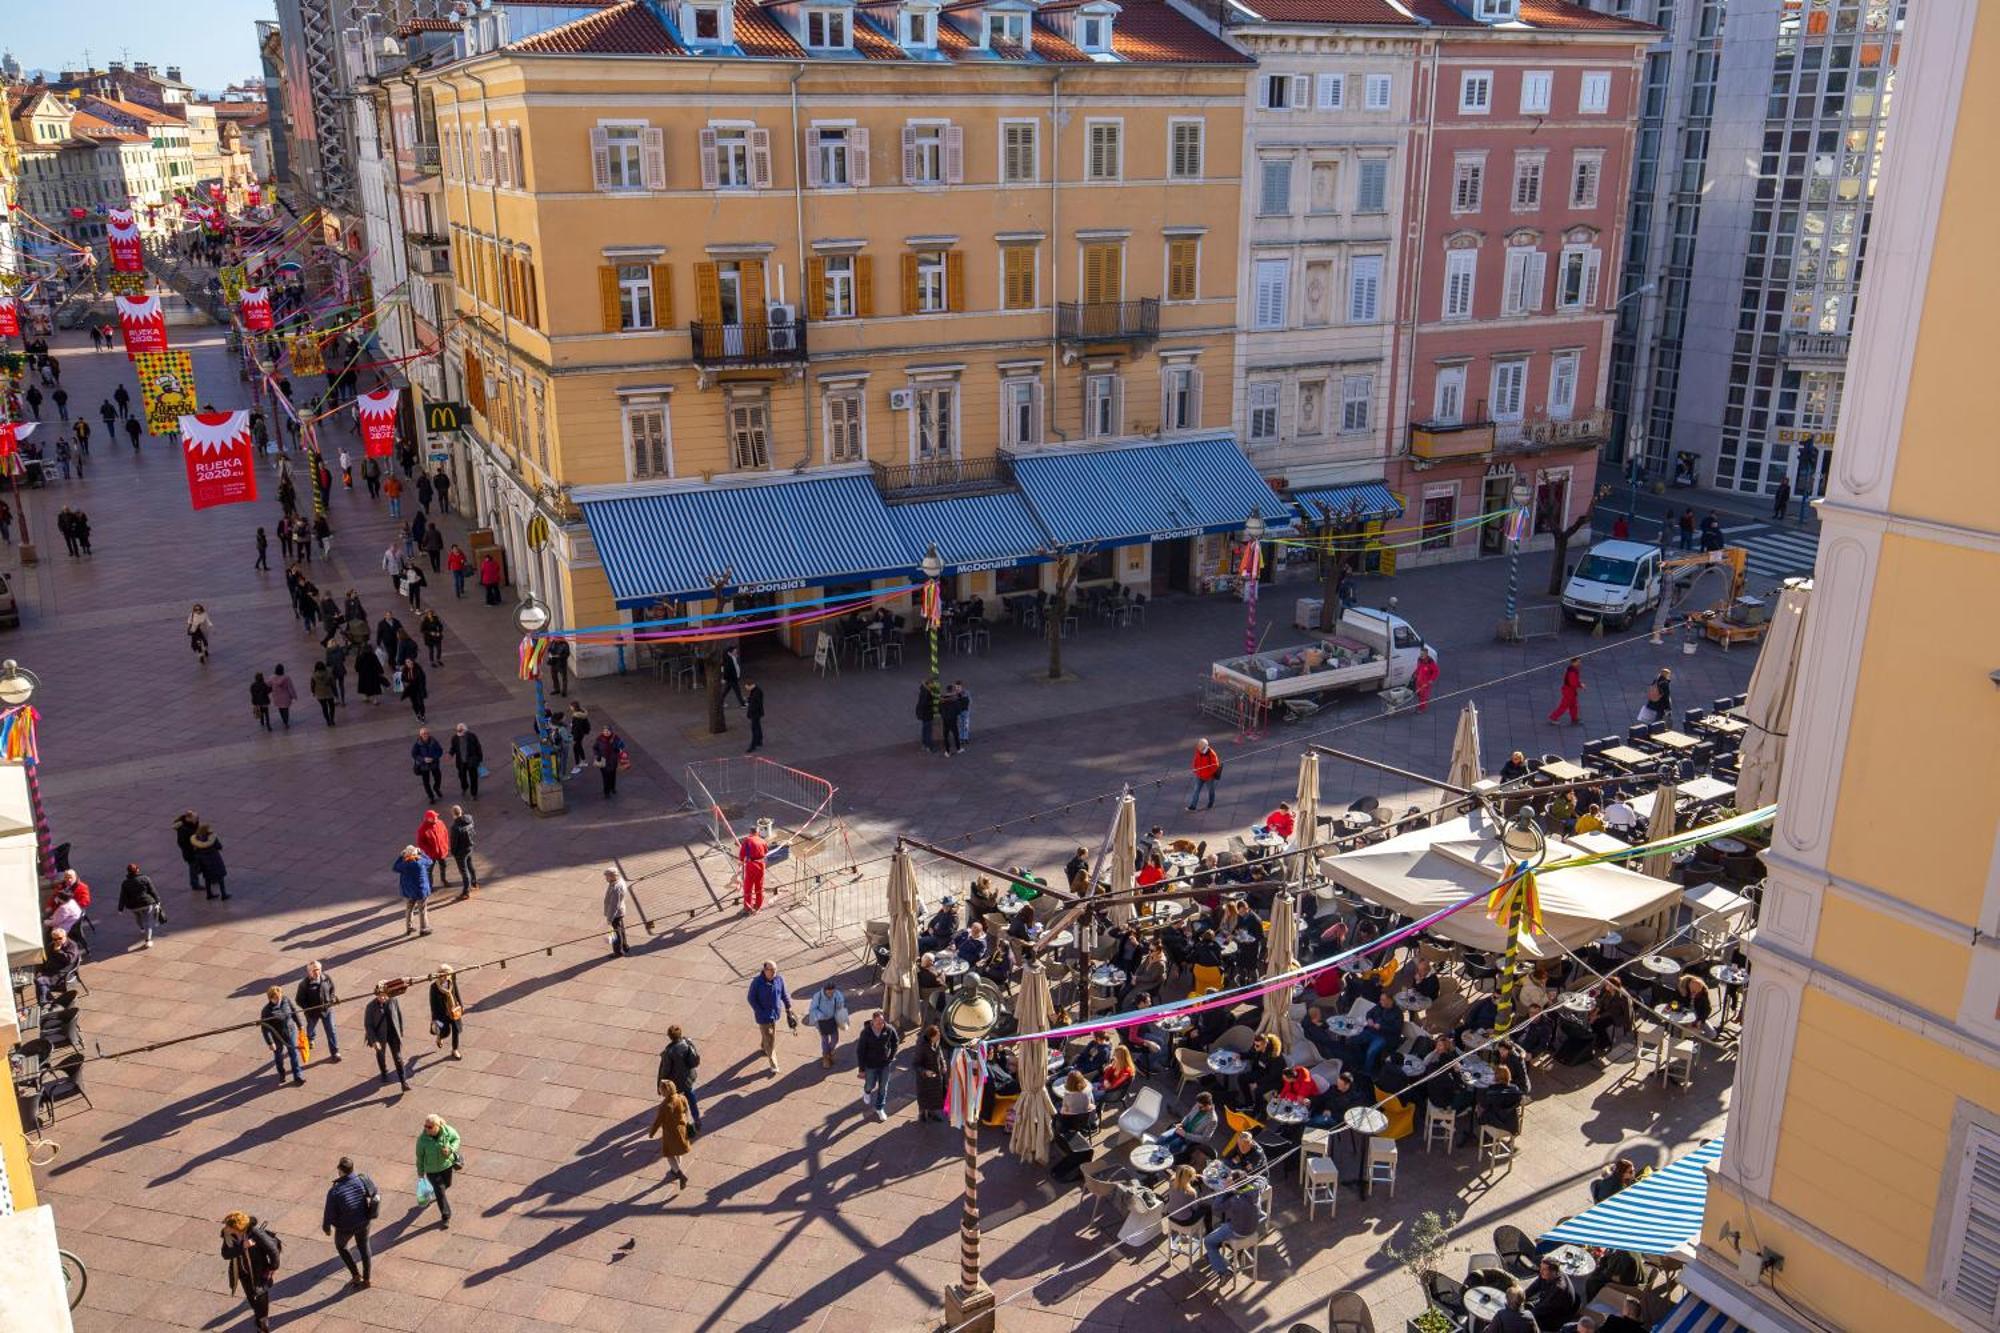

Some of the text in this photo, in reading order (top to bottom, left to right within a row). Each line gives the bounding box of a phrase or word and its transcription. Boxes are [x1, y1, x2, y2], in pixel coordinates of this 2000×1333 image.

[195, 457, 242, 472] RIJEKA
[1487, 462, 1516, 477] ANA
[1150, 527, 1205, 542] McDonald's
[956, 557, 1017, 574] McDonald's
[737, 579, 807, 594] McDonald's
